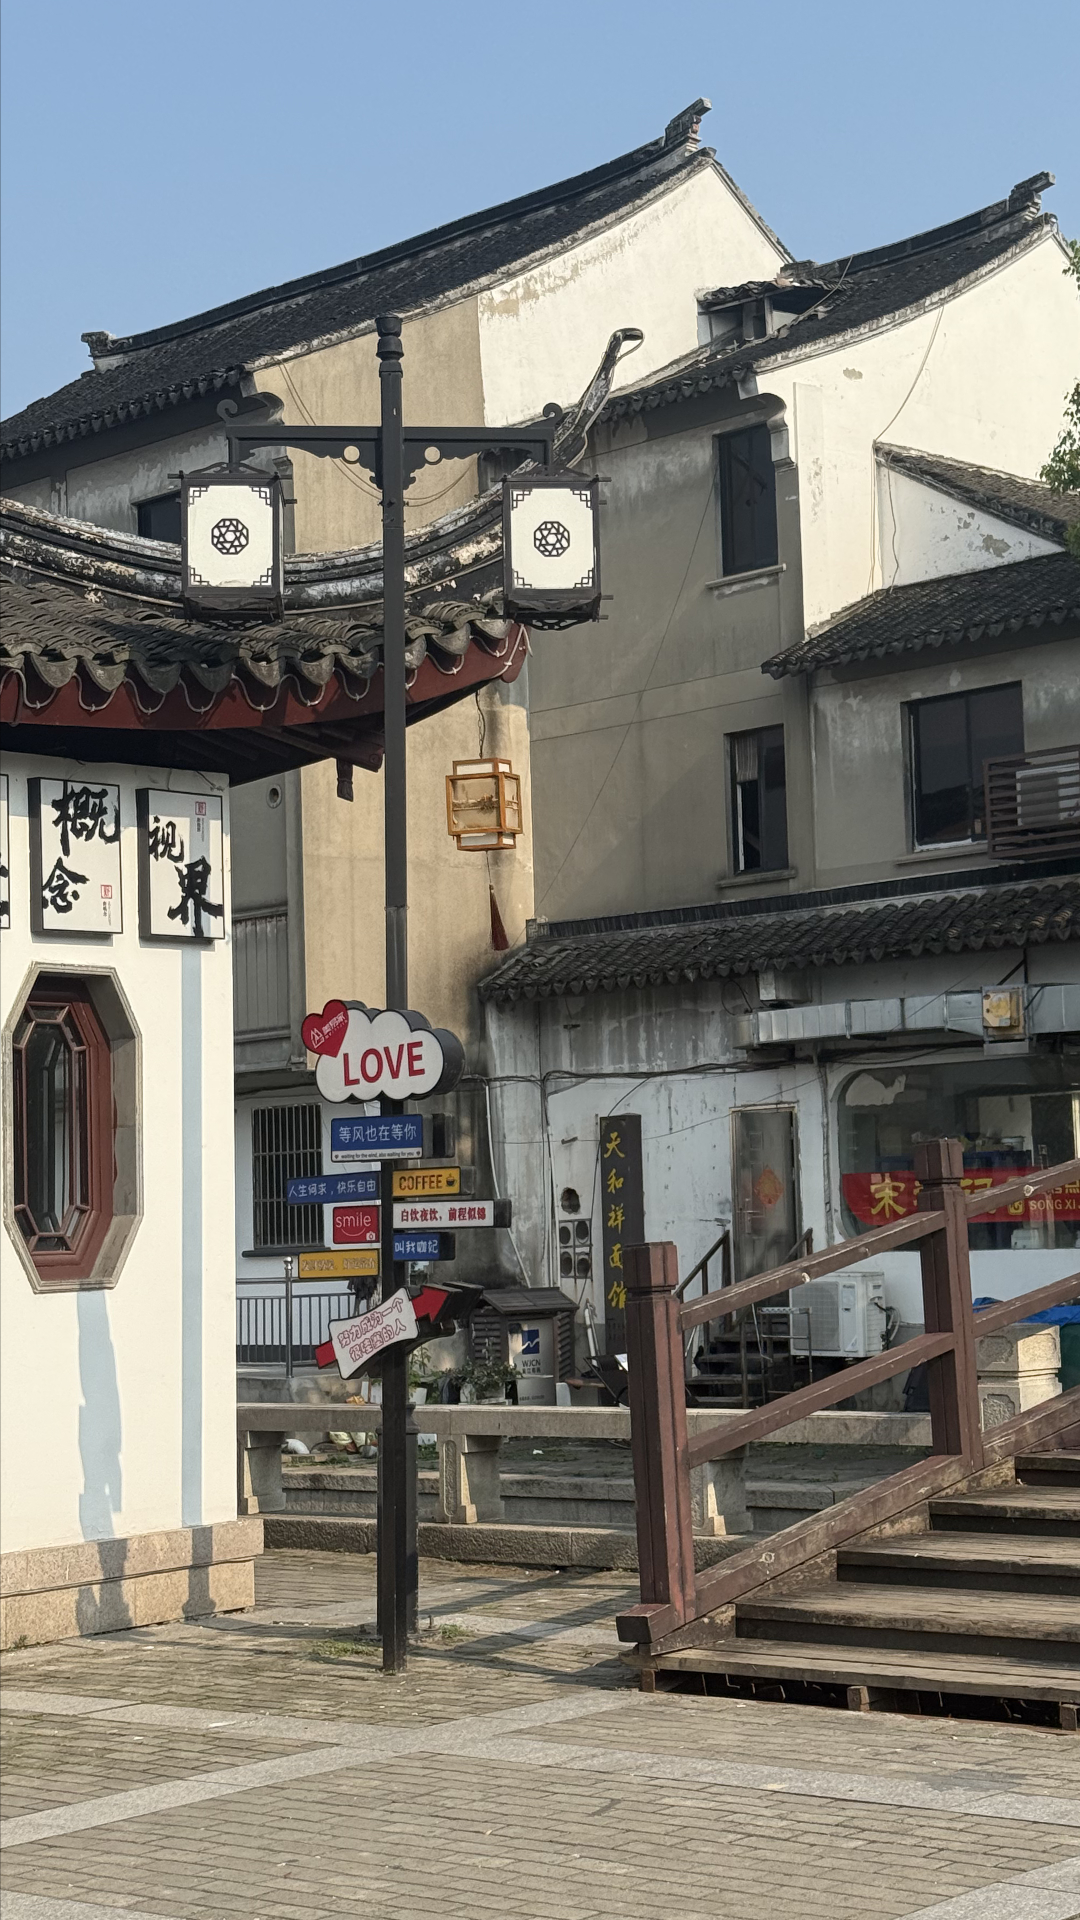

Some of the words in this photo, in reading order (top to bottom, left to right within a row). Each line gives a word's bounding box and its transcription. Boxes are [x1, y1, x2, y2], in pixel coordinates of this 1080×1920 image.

[343, 1041, 425, 1087] LOVE
[339, 1123, 417, 1143] 等风也在等你
[399, 1174, 443, 1191] COFFEE
[1029, 1199, 1063, 1210] SONG
[335, 1212, 372, 1228] smile
[337, 1297, 403, 1348] 努力成为一个
[522, 1359, 541, 1367] WJCN
